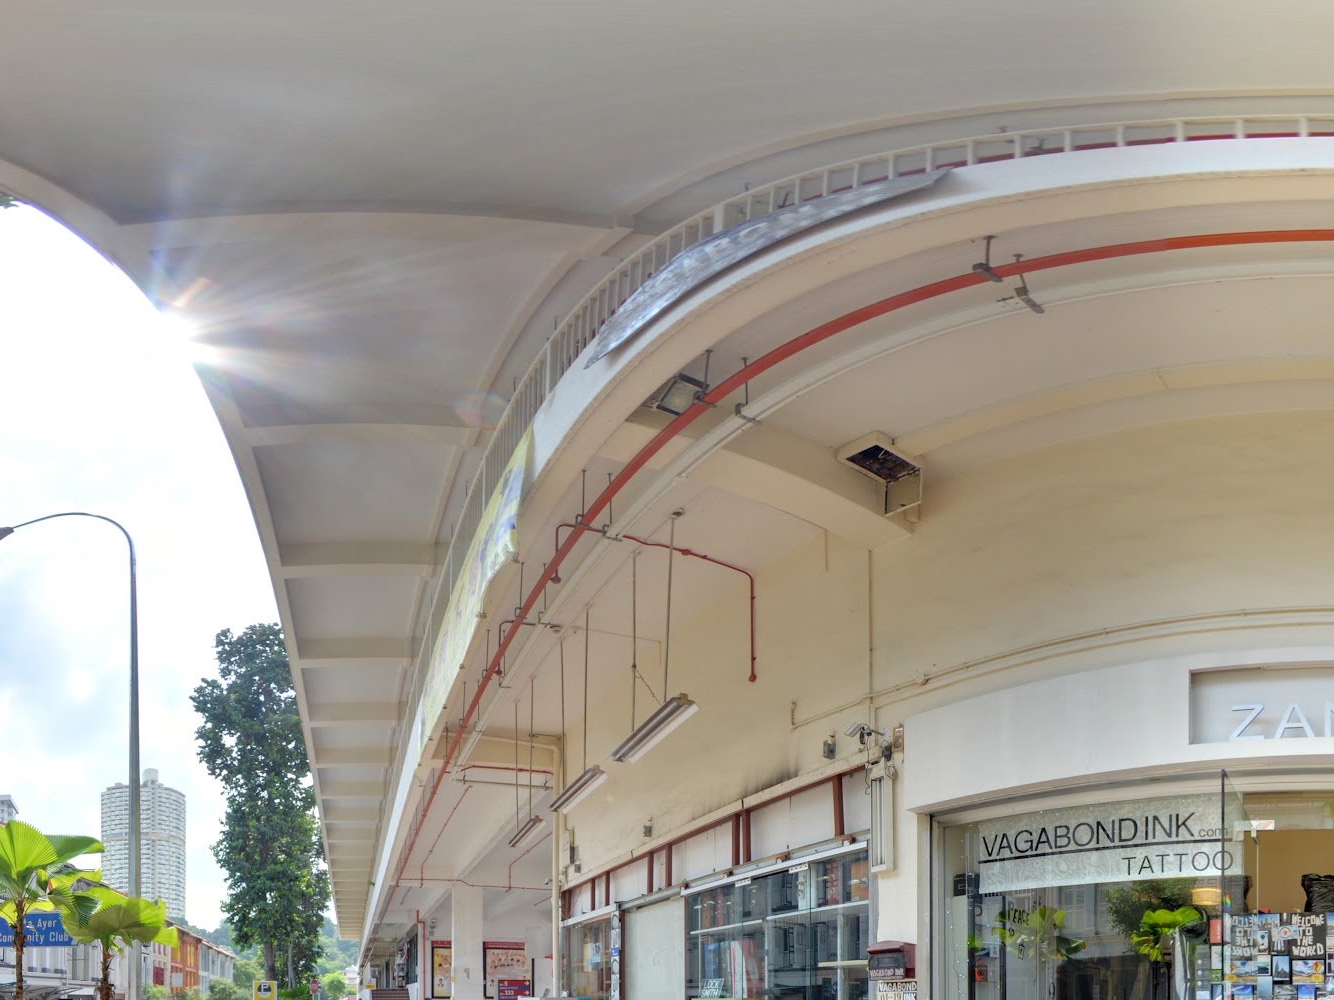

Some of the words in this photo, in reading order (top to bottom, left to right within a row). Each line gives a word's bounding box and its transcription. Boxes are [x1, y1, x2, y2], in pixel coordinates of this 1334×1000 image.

[1122, 850, 1234, 876] TATTOO
[36, 918, 57, 930] Ayer
[1291, 914, 1325, 927] WELCOME
[49, 931, 69, 942] Club
[1296, 936, 1314, 945] THE
[1291, 943, 1325, 958] WORLD
[869, 968, 894, 978] VAGABOND
[894, 968, 905, 976] INK
[703, 980, 720, 989] LOCK
[878, 981, 917, 992] VAGABOND
[700, 989, 719, 998] SMITH
